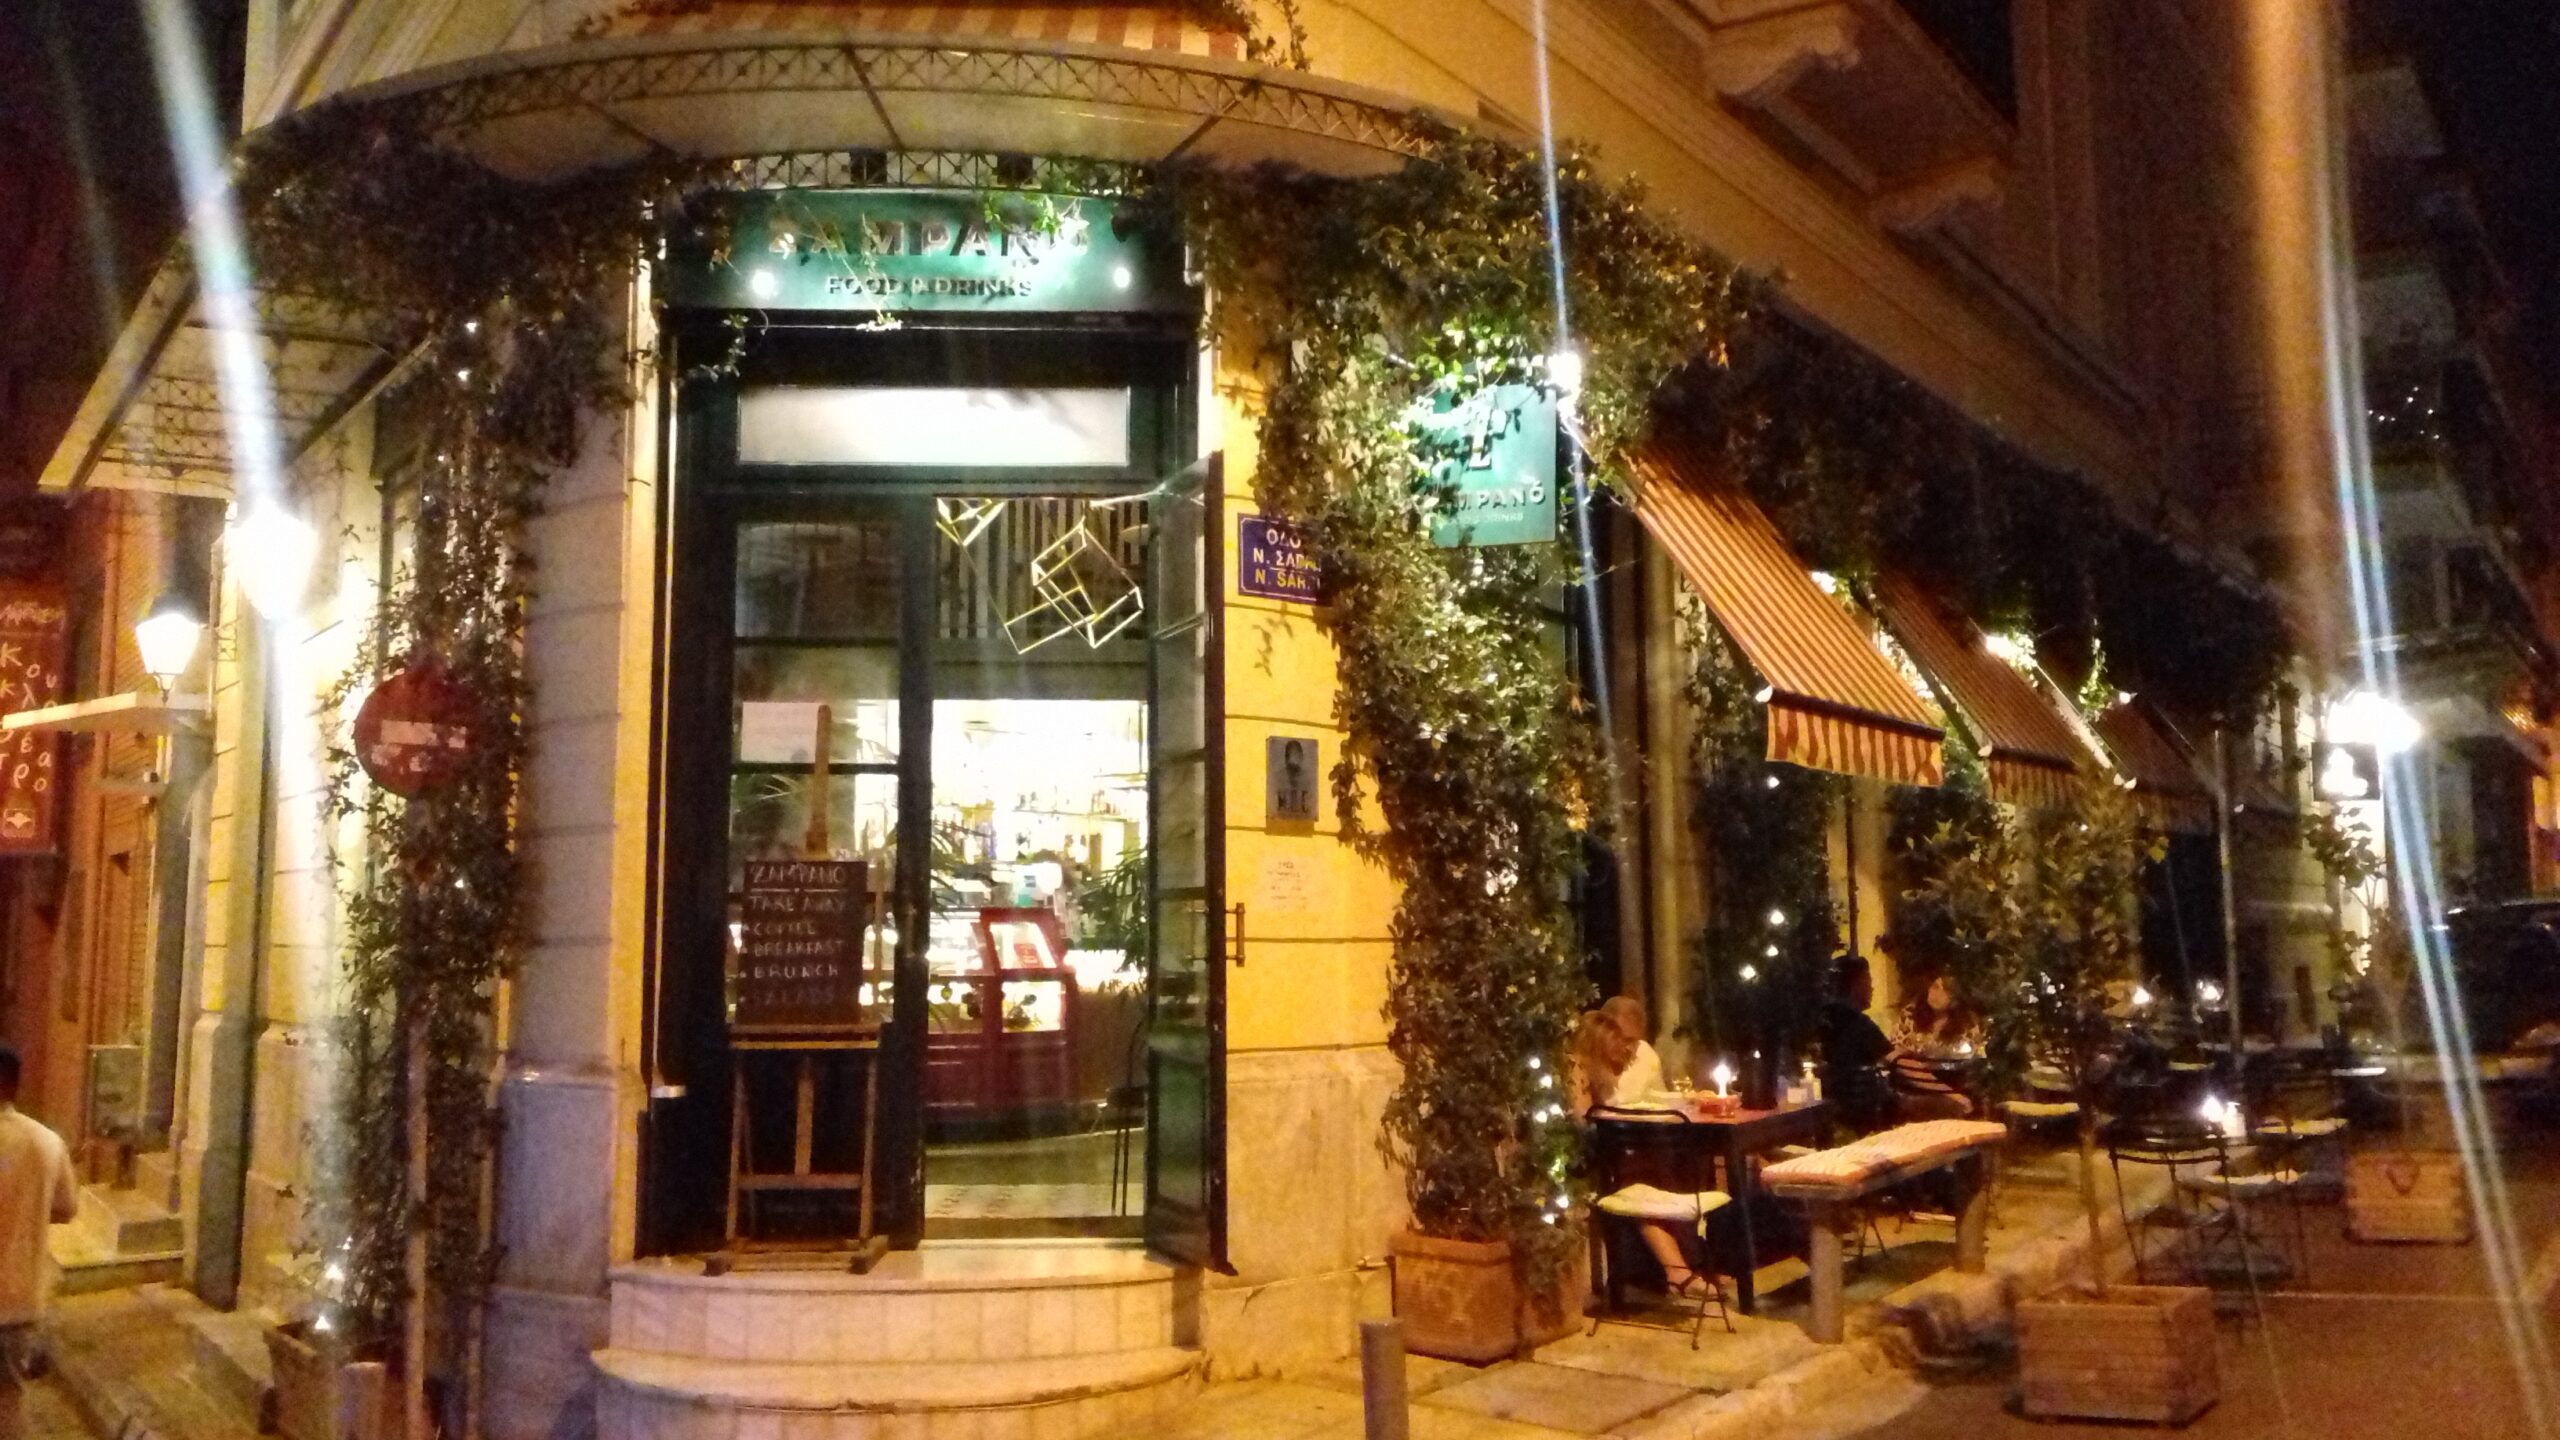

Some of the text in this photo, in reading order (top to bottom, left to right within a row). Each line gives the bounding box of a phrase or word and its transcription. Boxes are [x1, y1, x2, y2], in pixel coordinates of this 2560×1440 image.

[827, 275, 901, 295] FOOD
[935, 277, 1032, 297] DRINKS
[1266, 529, 1302, 549] ΟΔΟ
[749, 895, 794, 911] TAKE
[754, 965, 839, 979] BRUNCH
